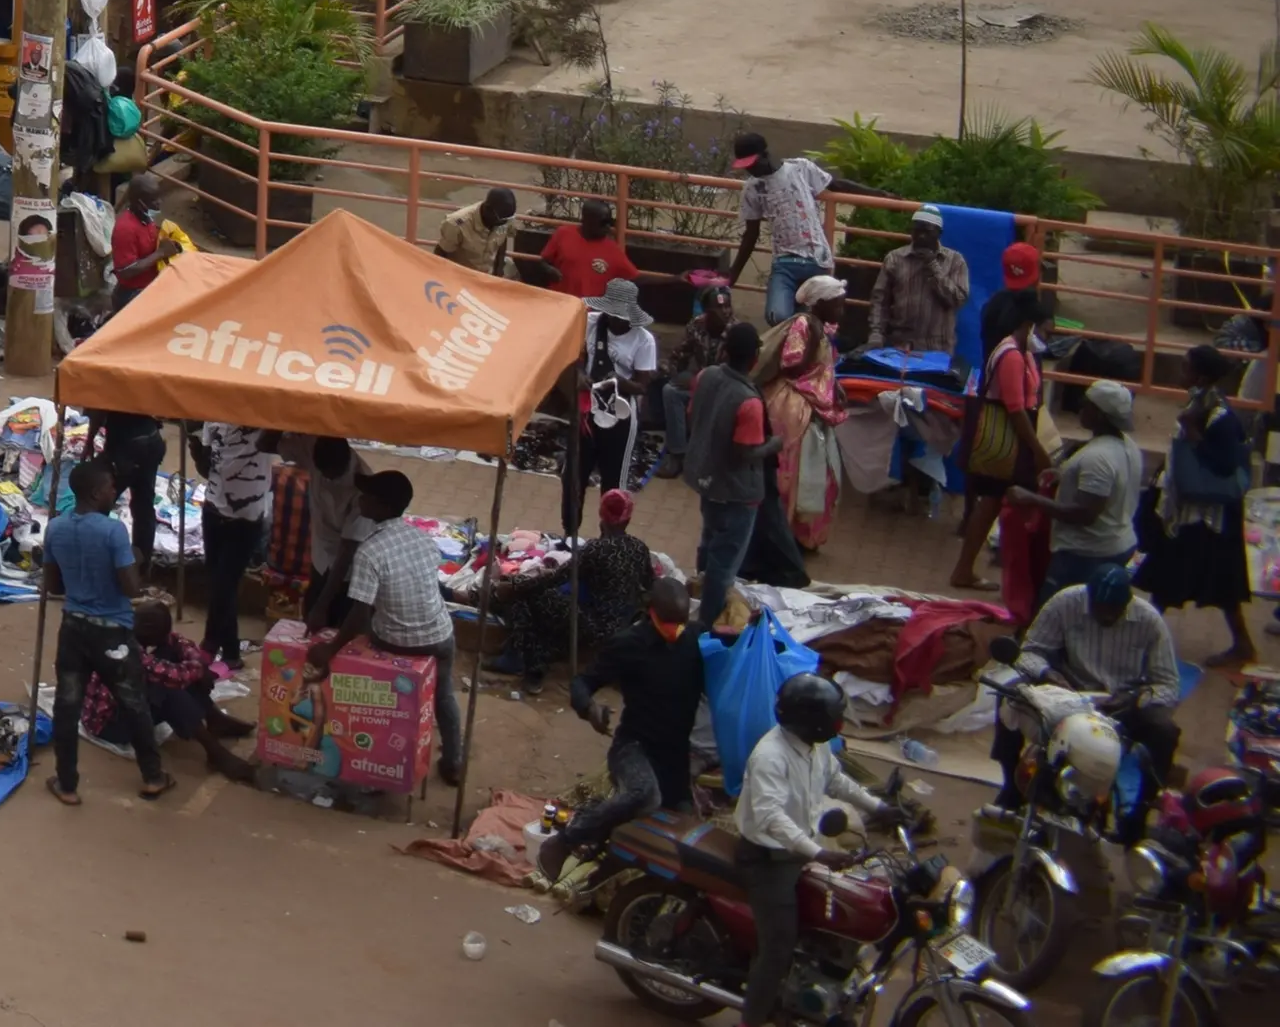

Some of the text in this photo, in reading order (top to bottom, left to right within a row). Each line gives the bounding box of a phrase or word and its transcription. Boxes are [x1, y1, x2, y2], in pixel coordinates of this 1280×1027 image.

[416, 288, 510, 392] africell
[166, 319, 394, 396] africell
[270, 684, 288, 702] 4G
[332, 675, 390, 693] MEET OUR
[335, 690, 396, 706] BUNDLES
[350, 707, 373, 716] BEST
[374, 709, 410, 719] OFFERS
[361, 717, 391, 727] TOWN
[351, 757, 404, 779] africell
